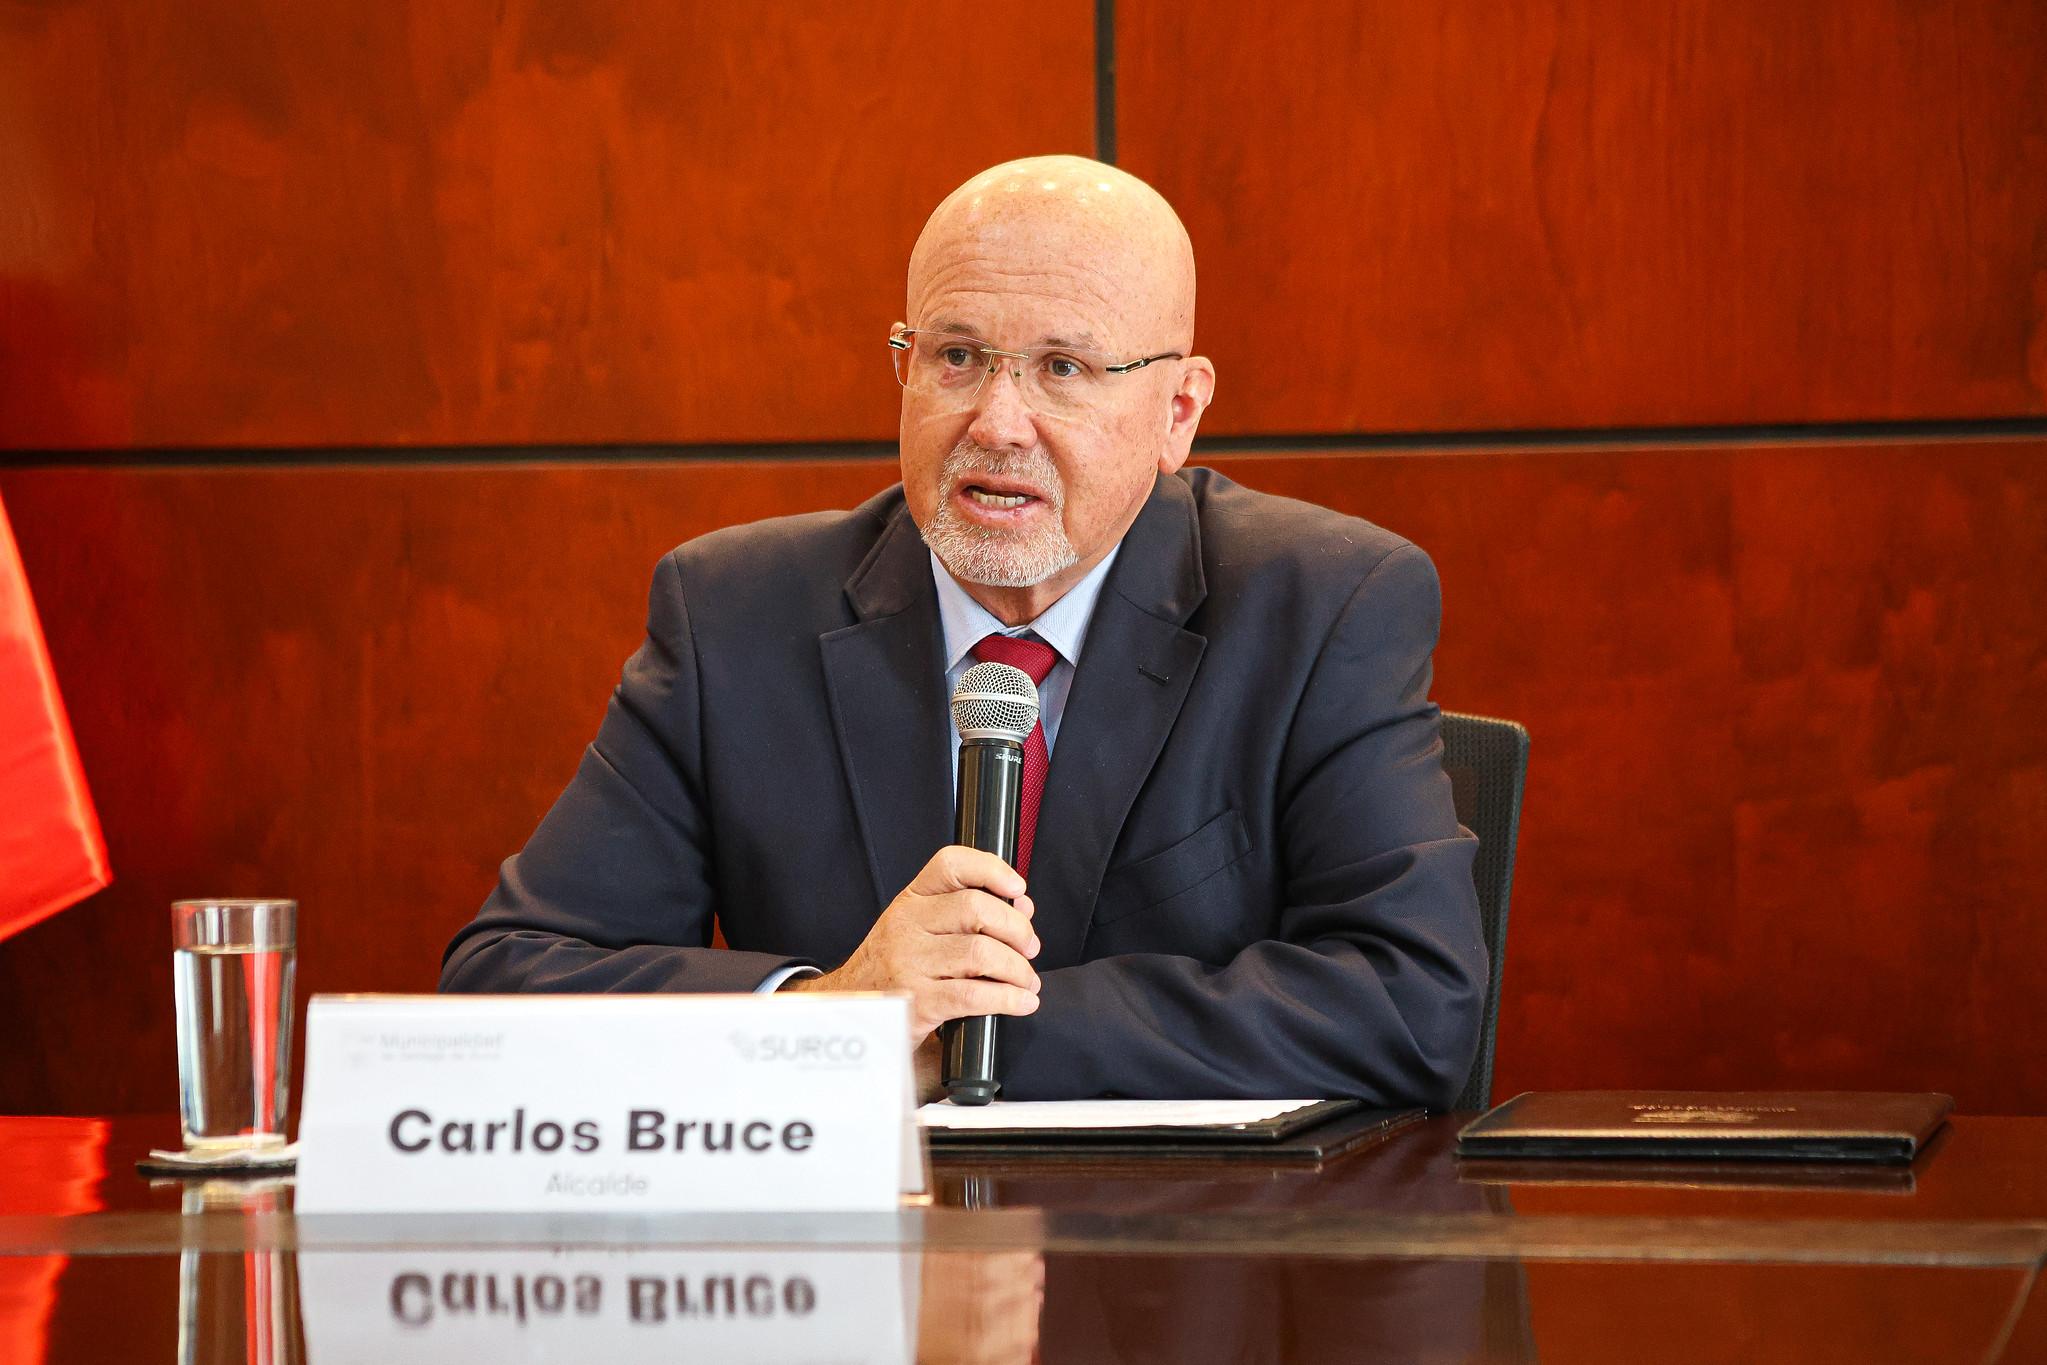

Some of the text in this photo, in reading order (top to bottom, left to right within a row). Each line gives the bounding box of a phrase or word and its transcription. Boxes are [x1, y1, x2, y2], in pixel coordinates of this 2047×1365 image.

[759, 1034, 867, 1061] SURCO
[387, 1107, 816, 1155] Carlos Bruce
[544, 1170, 649, 1196] Alcalde
